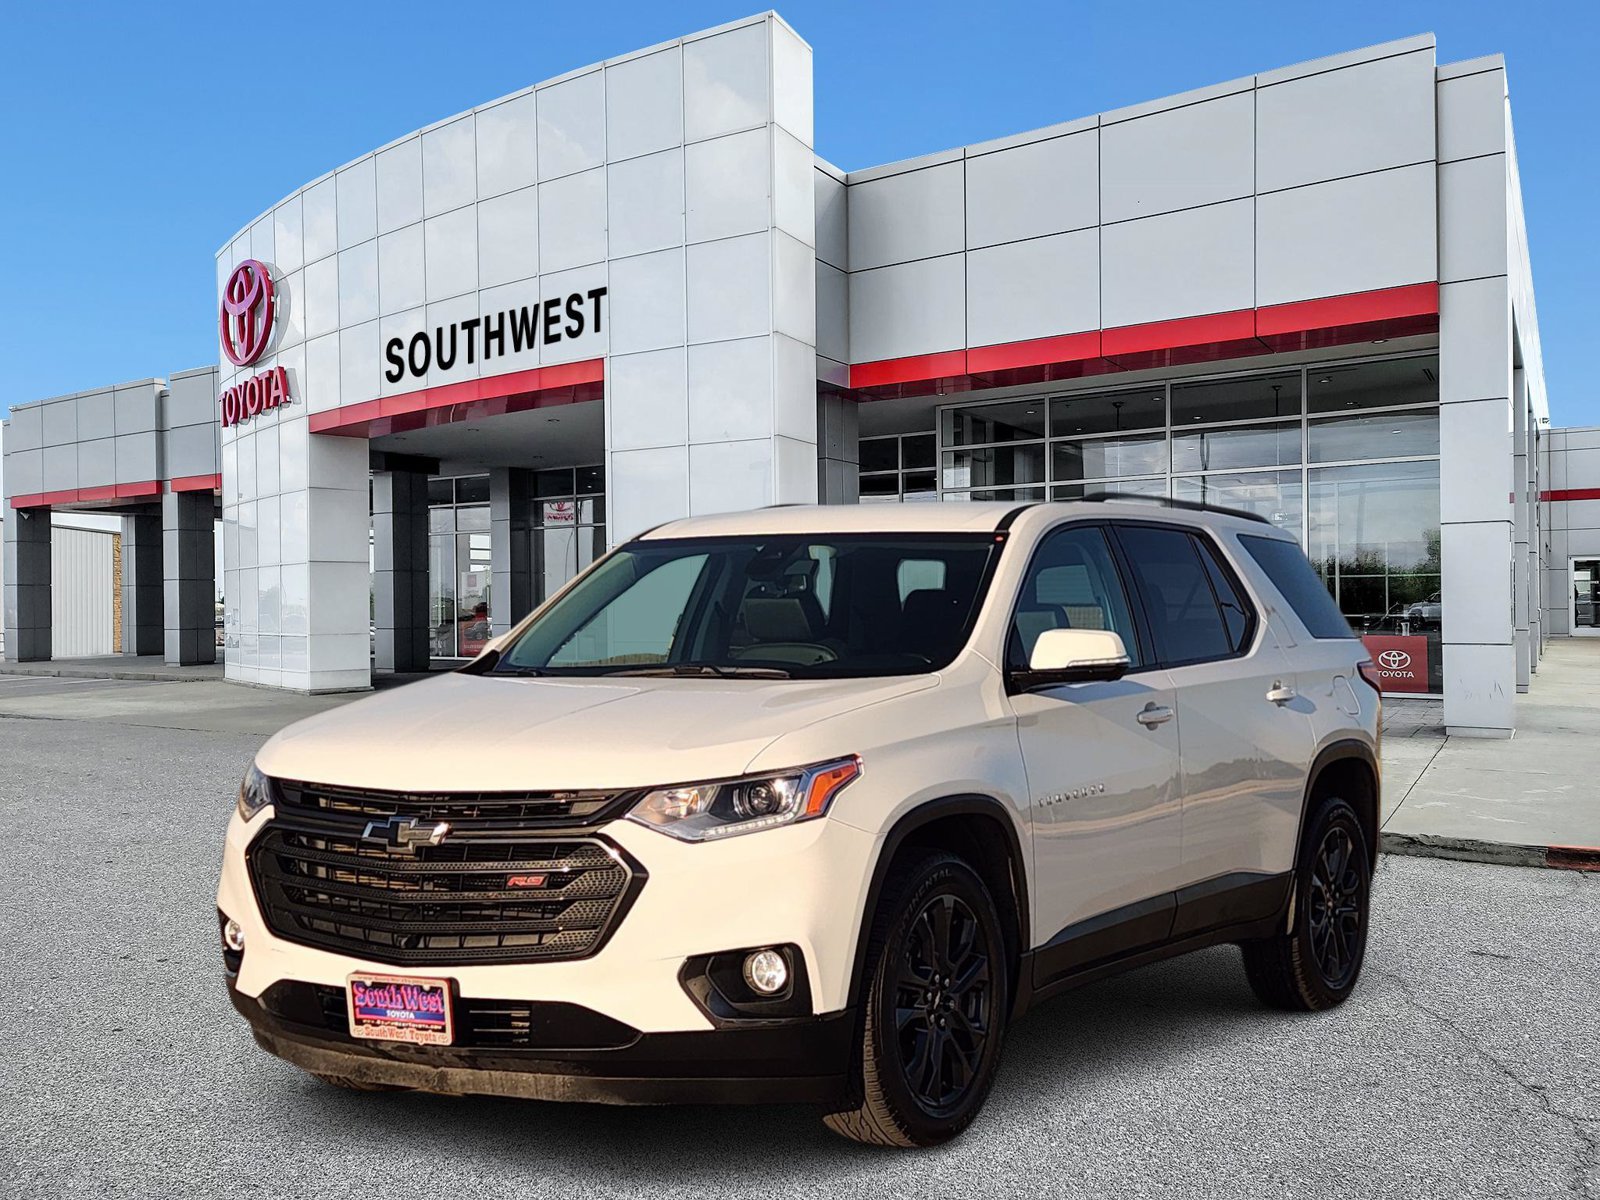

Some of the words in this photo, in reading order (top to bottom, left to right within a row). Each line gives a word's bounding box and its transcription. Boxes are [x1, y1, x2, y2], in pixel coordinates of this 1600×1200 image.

[385, 287, 608, 384] SOUTHWEST
[218, 366, 290, 427] TOYOTA
[1377, 670, 1414, 678] TOYOTA
[508, 876, 545, 886] RS
[386, 1010, 415, 1019] TOYOTA
[409, 1030, 437, 1043] Toyota
